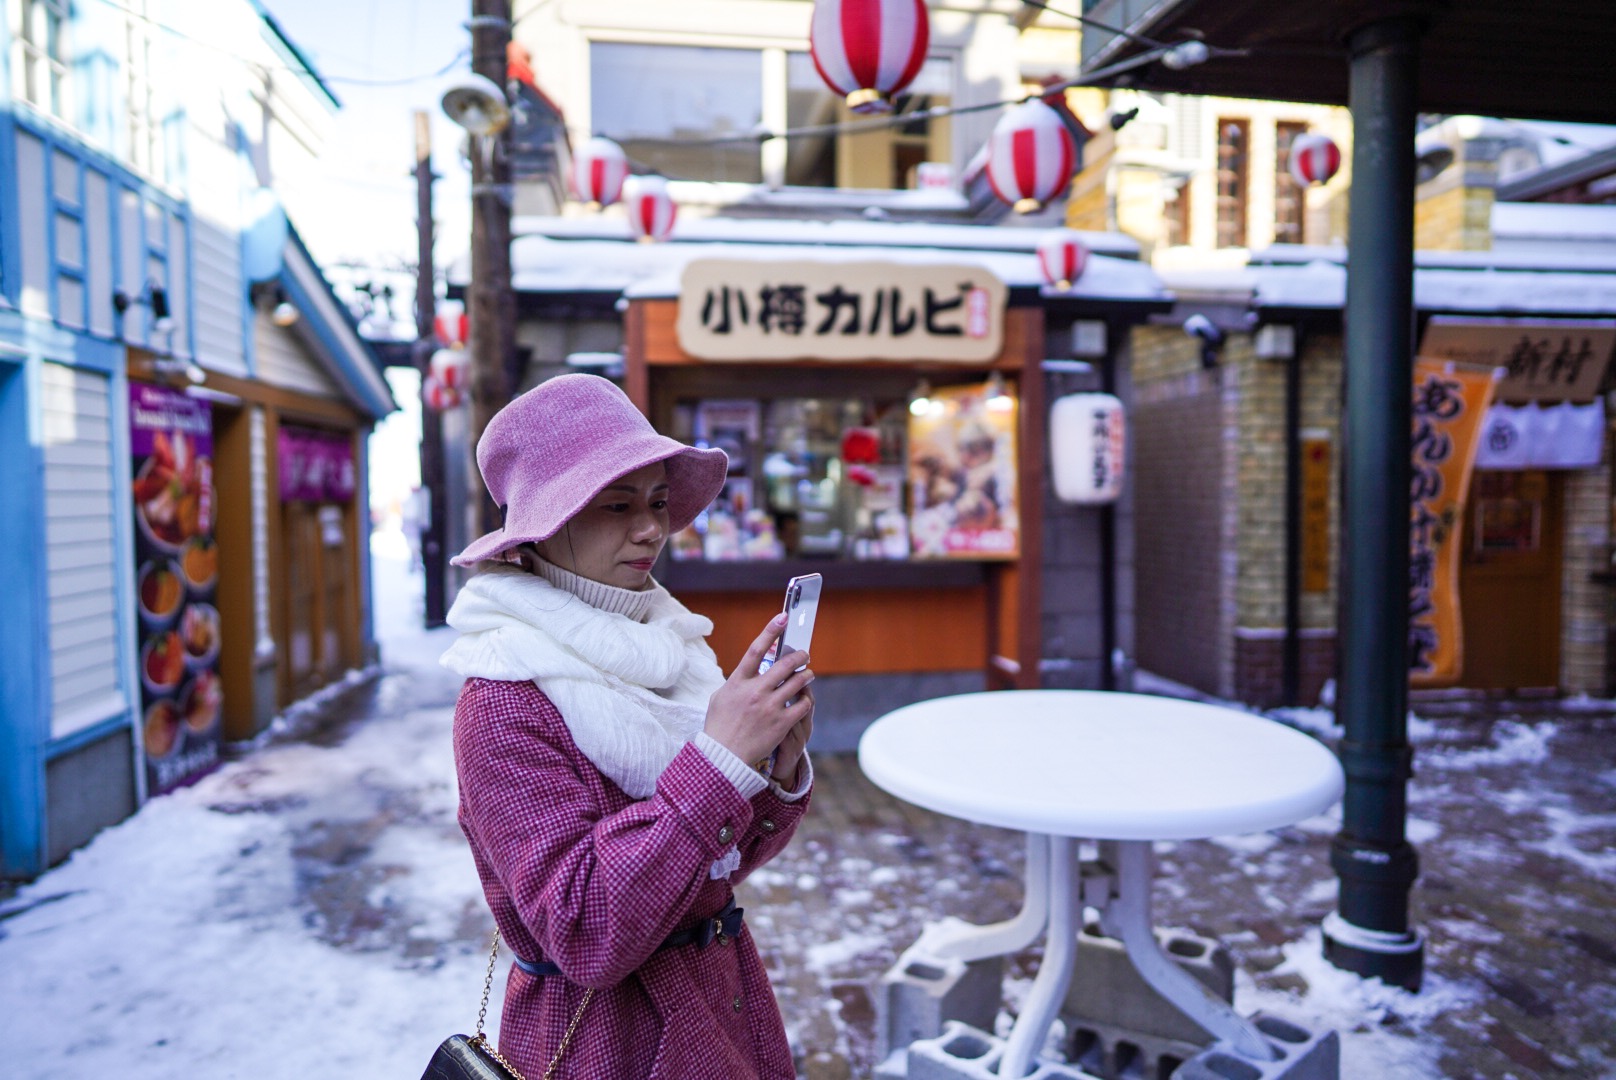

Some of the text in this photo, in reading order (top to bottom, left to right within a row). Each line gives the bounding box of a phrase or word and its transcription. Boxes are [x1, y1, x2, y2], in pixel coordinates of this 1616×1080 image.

[702, 281, 974, 336] 小樽カルビ
